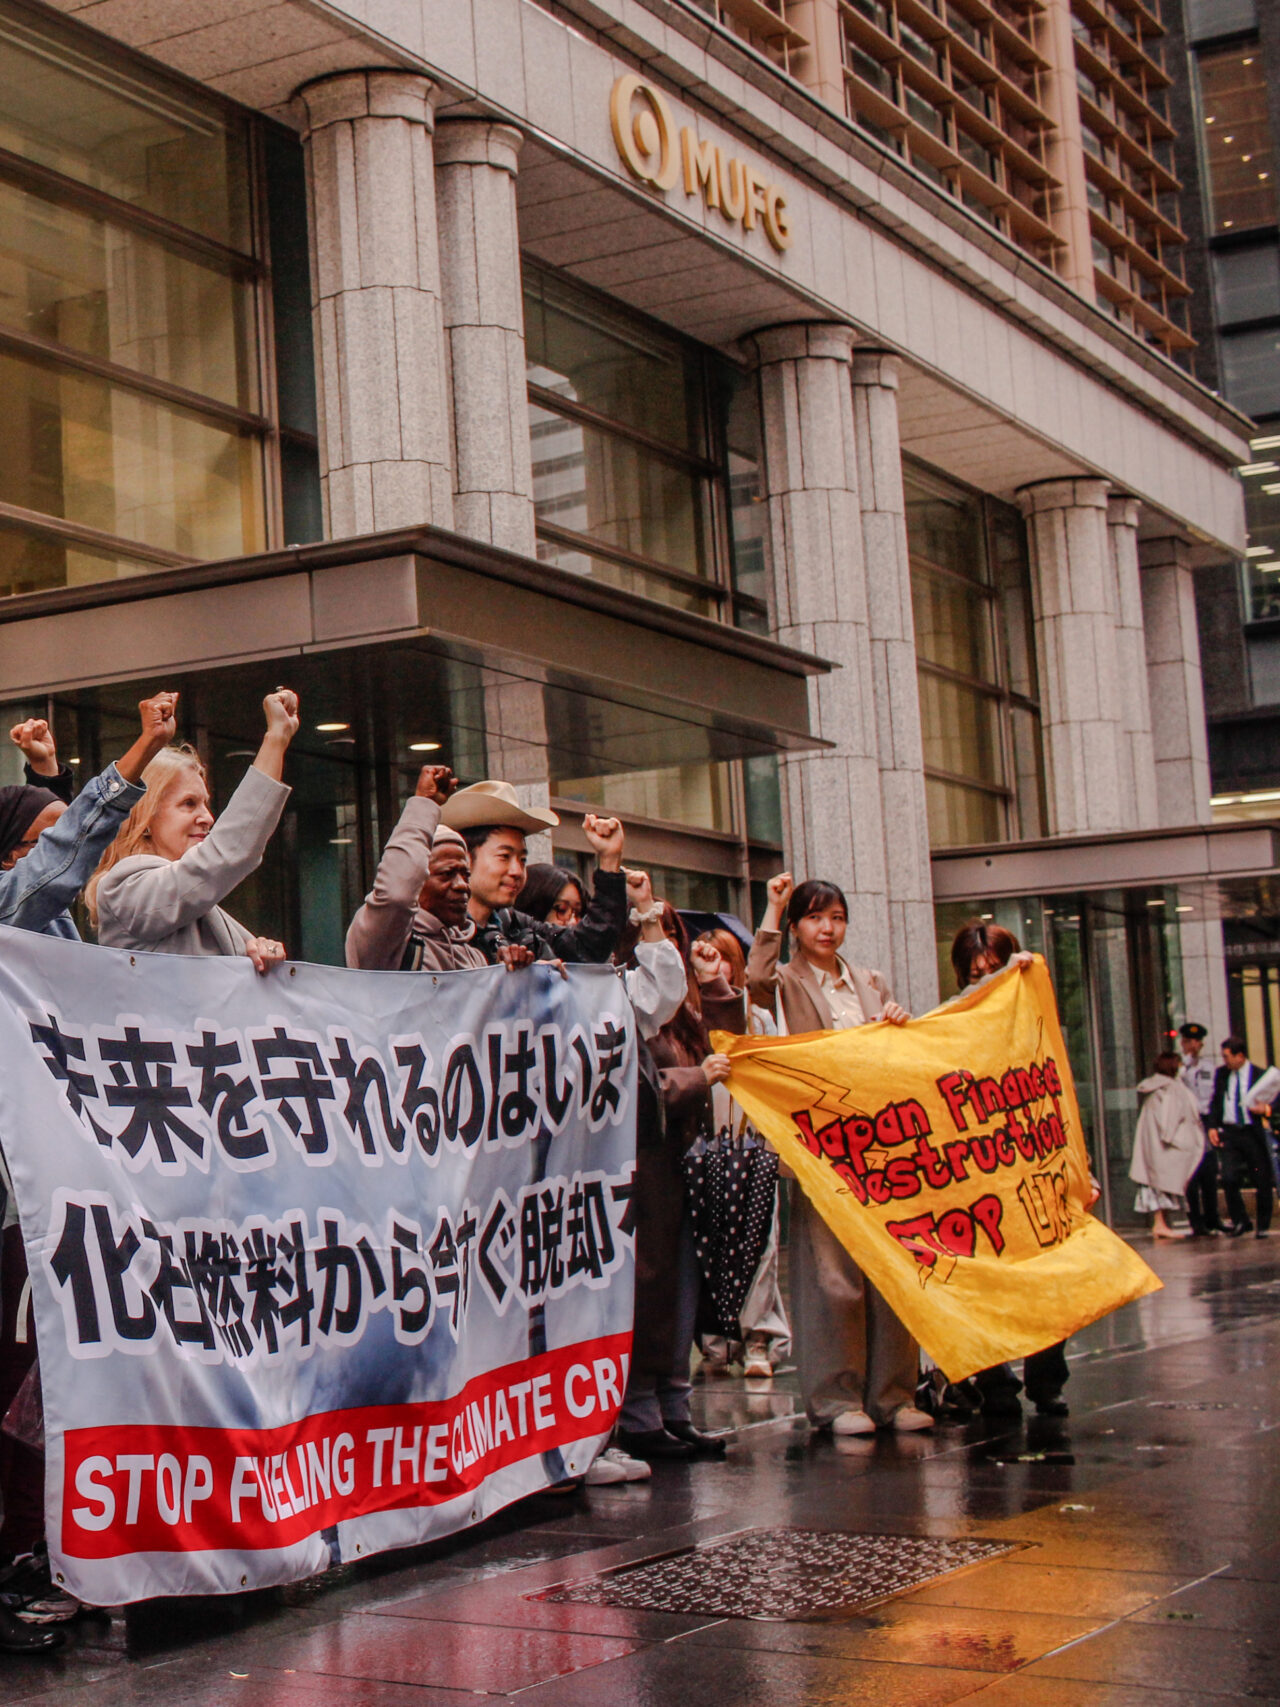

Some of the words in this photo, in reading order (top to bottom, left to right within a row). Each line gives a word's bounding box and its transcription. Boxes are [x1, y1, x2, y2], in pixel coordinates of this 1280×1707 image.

[680, 125, 794, 252] MUFG
[791, 1098, 933, 1175] Japan
[936, 1056, 1063, 1132] Finances
[885, 1193, 1005, 1267] STOP
[72, 1453, 214, 1531] STOP
[230, 1432, 355, 1523] FUELING
[366, 1422, 449, 1488] THE
[451, 1373, 556, 1475] CLIMATE
